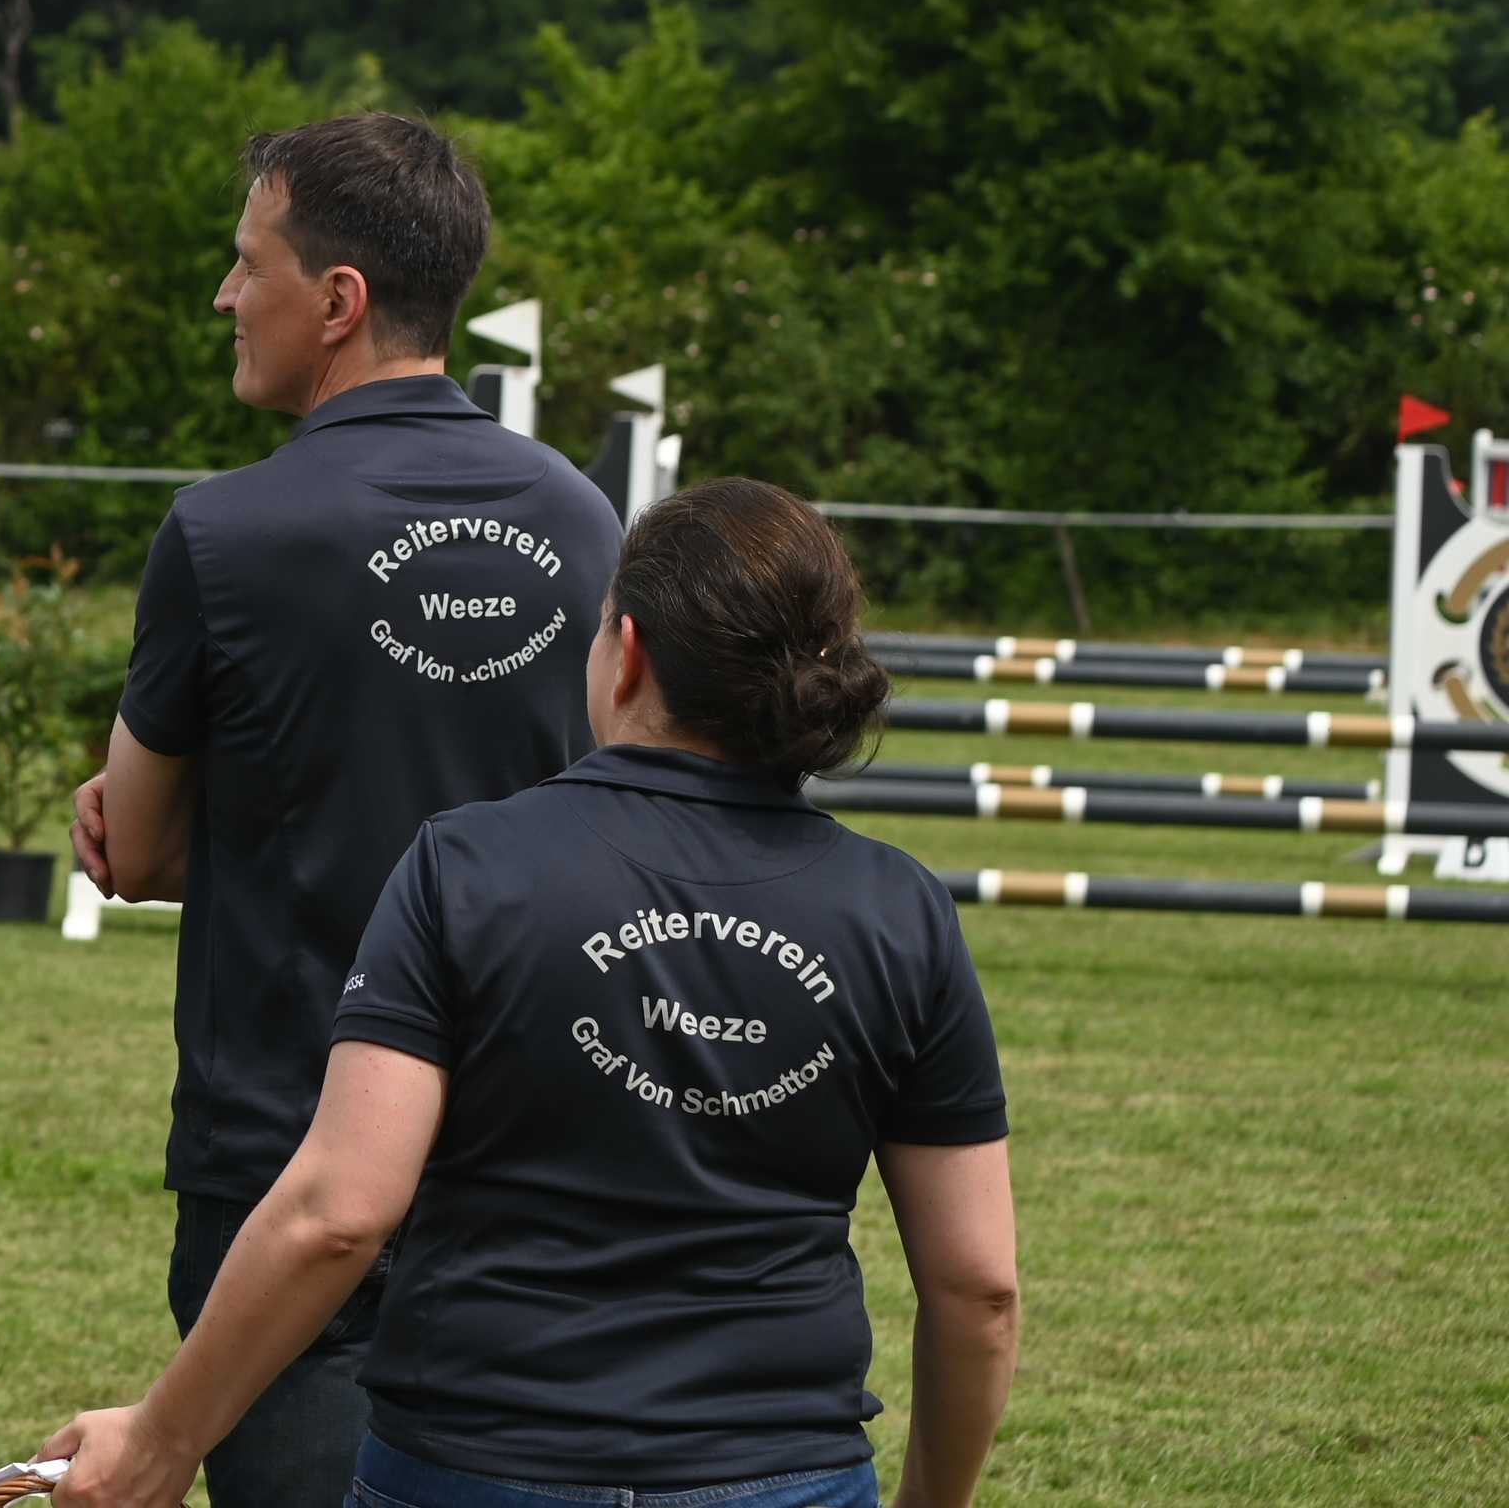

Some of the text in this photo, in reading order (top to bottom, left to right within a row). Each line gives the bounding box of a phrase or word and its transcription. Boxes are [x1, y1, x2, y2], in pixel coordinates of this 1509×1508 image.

[367, 517, 563, 583] Reiterverein
[419, 592, 517, 621] Weeze
[370, 619, 416, 665] Graf
[416, 650, 454, 683] Von
[581, 907, 836, 1004] Reiterverein
[641, 995, 767, 1044] Weeze
[571, 1016, 836, 1117] Graf Von Schmettow
